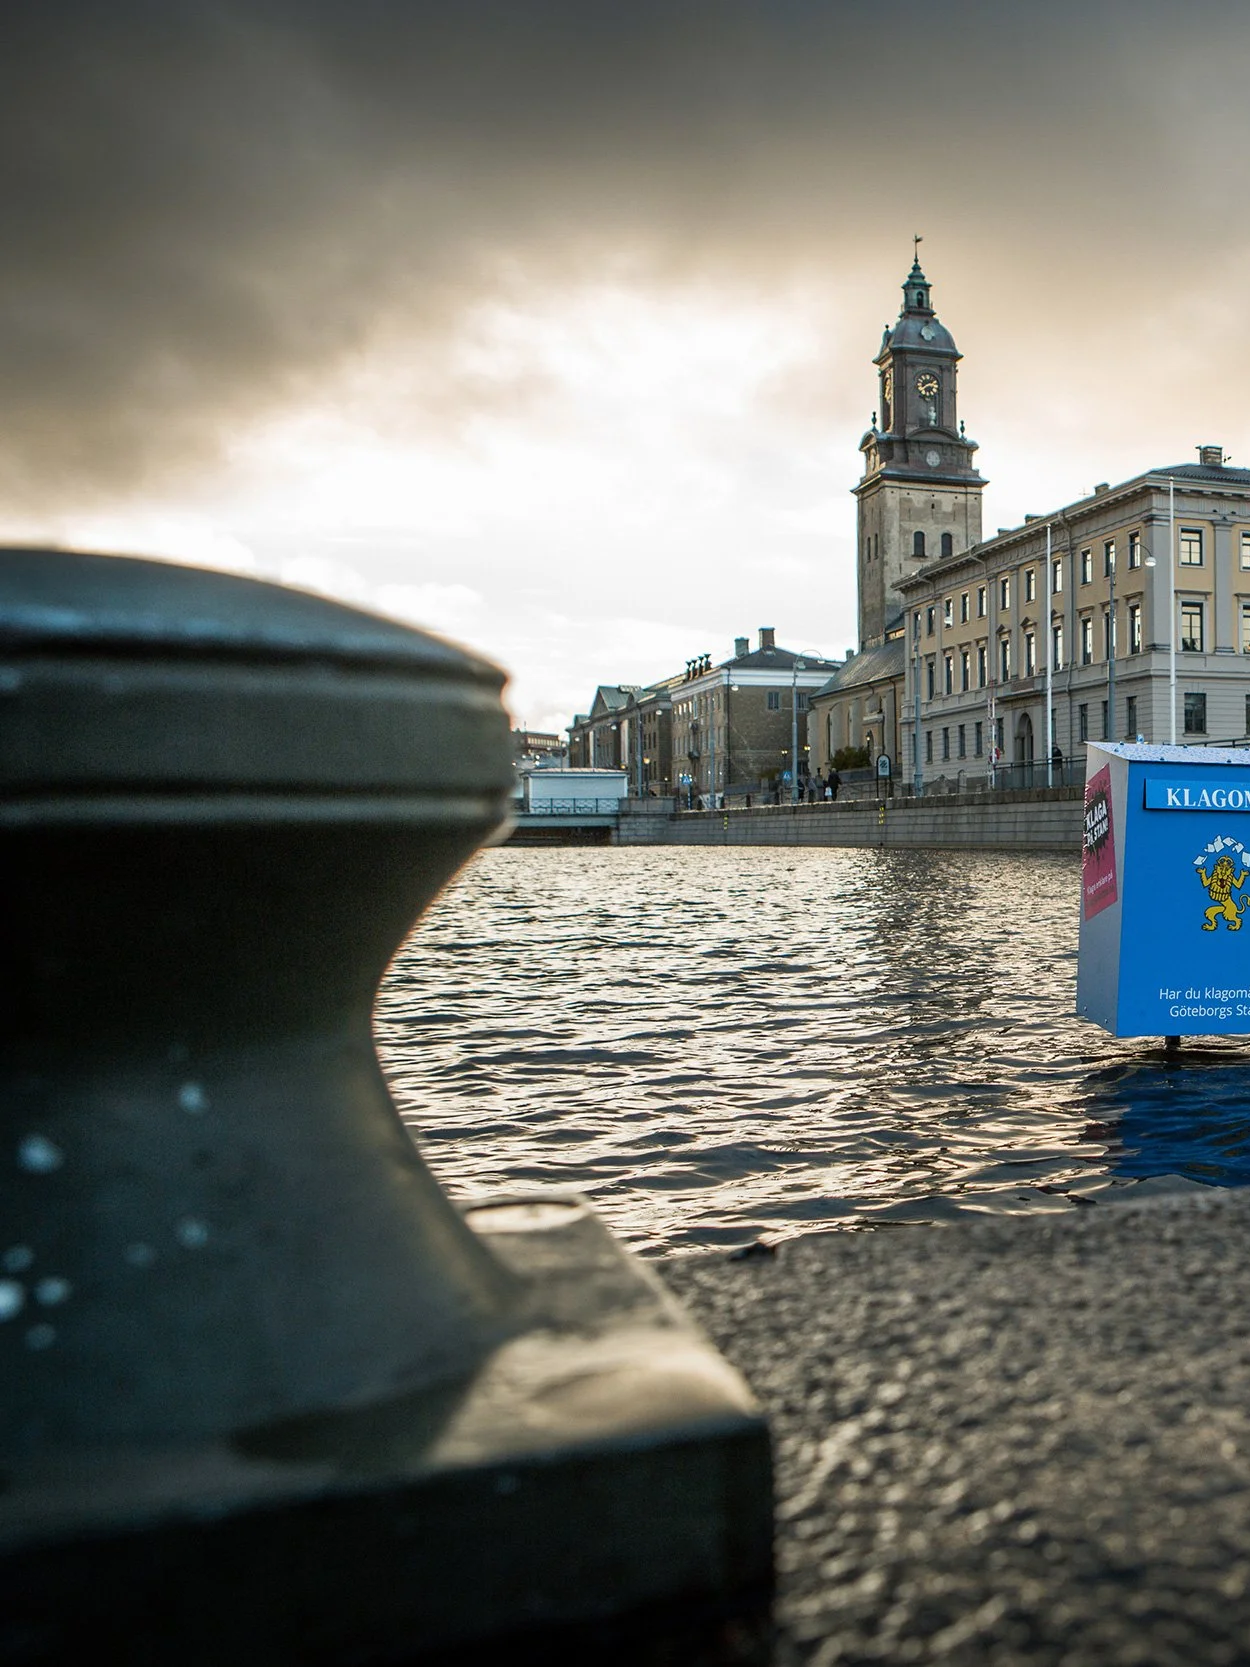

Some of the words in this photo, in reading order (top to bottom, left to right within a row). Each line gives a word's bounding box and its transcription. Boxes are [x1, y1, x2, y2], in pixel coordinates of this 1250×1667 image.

[1087, 800, 1107, 831] KLAGA
[1159, 988, 1182, 1000] Har
[1184, 987, 1201, 999] du
[1169, 1005, 1233, 1020] Göteborgs
